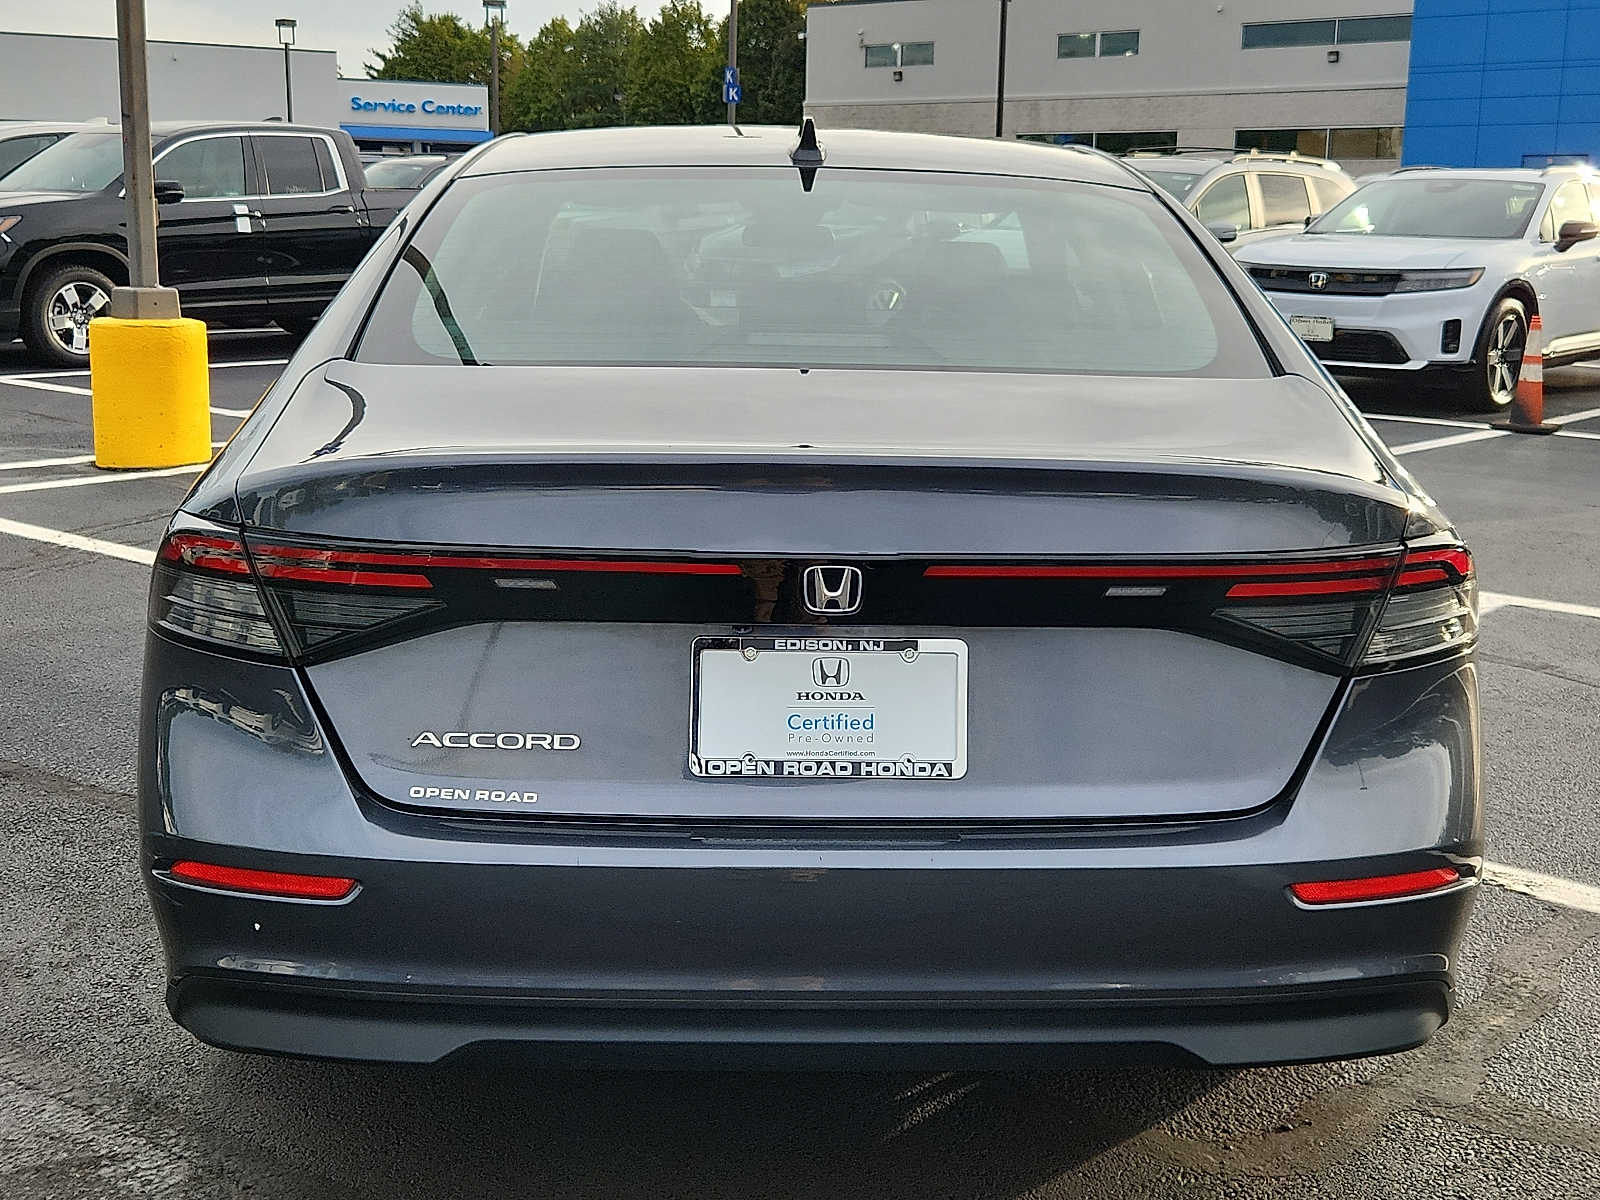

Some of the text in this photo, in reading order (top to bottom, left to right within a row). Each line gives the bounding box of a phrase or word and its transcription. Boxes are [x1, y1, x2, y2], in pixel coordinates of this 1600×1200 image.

[726, 70, 733, 84] K
[729, 87, 738, 101] K
[351, 96, 482, 116] Service Center
[774, 639, 884, 652] EDISON, NJ
[796, 691, 866, 701] HONDA
[787, 713, 875, 731] Certified
[411, 731, 581, 751] ACCORD
[788, 733, 874, 744] Pre-Owned
[786, 750, 876, 758] www.HondaCertified.com
[708, 759, 949, 777] OPEN ROAD HONDA
[409, 786, 538, 803] OPEN ROAD
